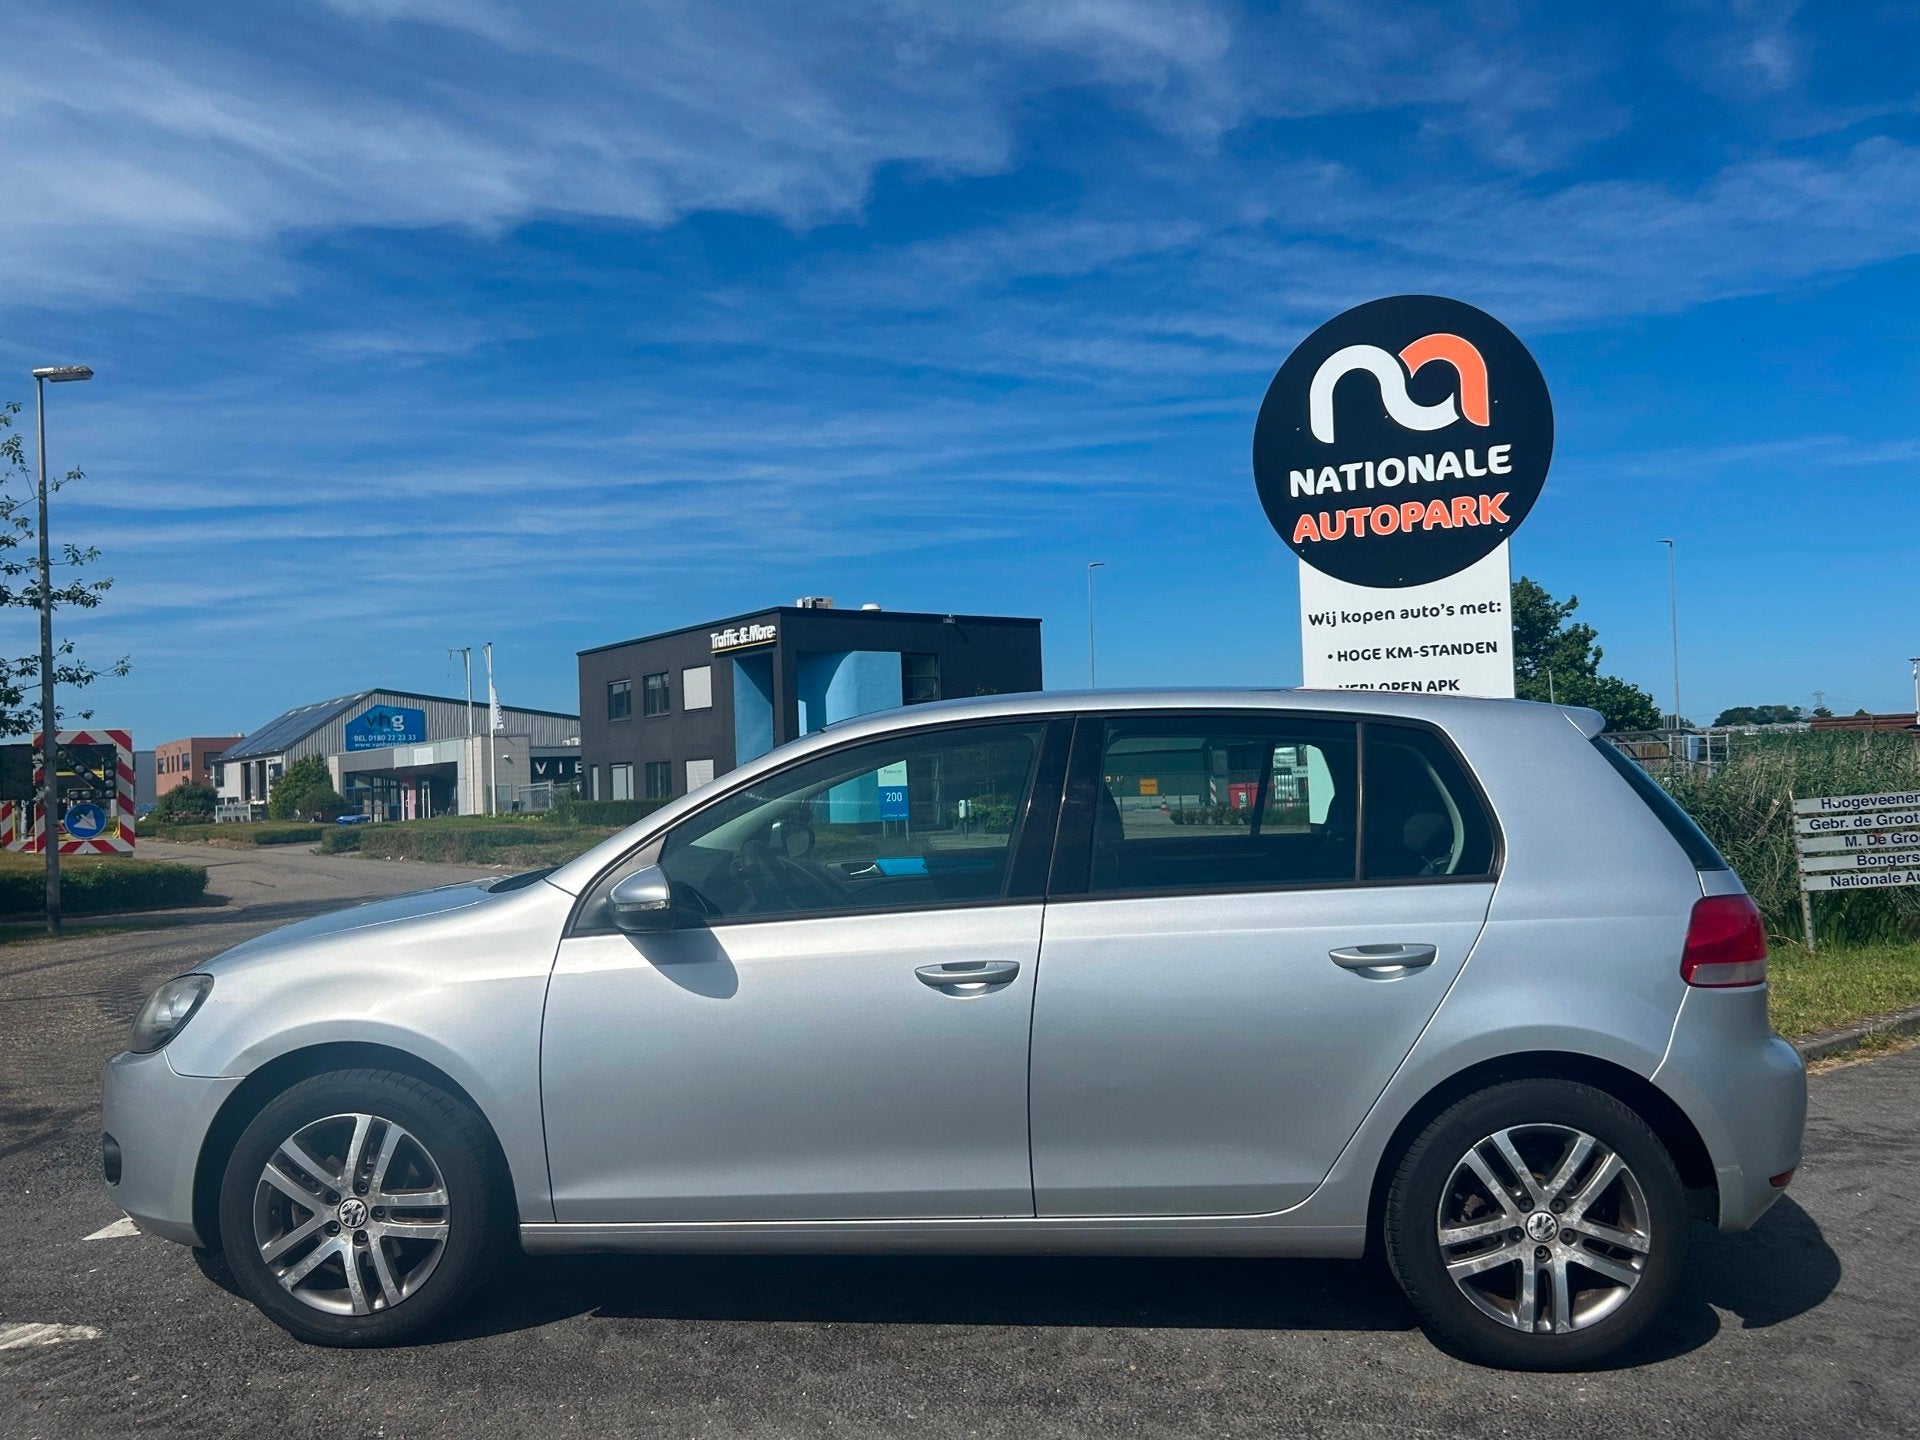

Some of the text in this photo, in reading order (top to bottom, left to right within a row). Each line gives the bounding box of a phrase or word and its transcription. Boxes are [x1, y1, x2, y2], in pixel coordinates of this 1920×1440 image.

[1289, 443, 1512, 498] NATIONALE
[1292, 491, 1511, 544] AUTOPARK
[1308, 600, 1502, 628] Wij kopen auto's met:
[710, 624, 776, 650] Traffic & More
[1337, 641, 1498, 662] HOGE KM-STANDEN
[1426, 679, 1460, 693] APK
[365, 711, 405, 732] vhg
[353, 734, 367, 742] BEL
[885, 791, 903, 802] 200
[1809, 812, 1919, 830] Gebr. de Groot
[1844, 832, 1920, 847] M. De Gro
[1856, 853, 1920, 867] Bongers
[1830, 872, 1902, 887] Nationale
